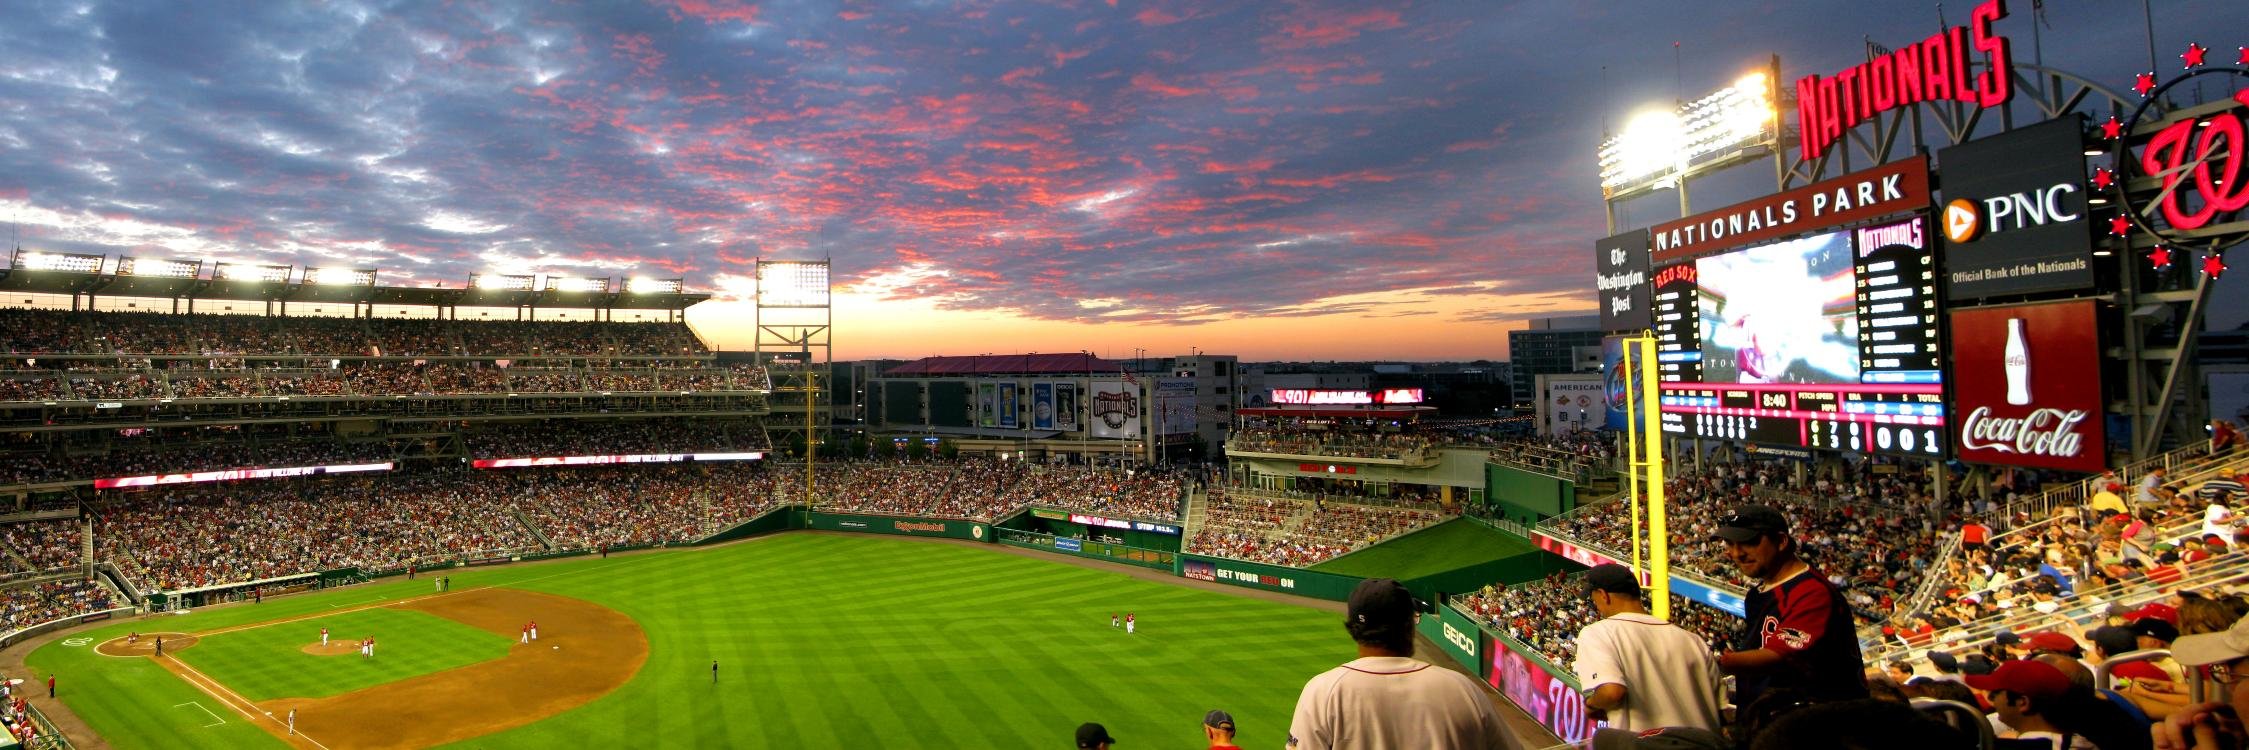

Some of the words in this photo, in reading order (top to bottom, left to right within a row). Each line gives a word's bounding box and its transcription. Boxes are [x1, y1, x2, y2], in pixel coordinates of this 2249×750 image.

[1796, 0, 2014, 160] NATIONALS
[1656, 200, 1796, 251] NATIONALS
[1813, 173, 1901, 217] PARK
[1984, 183, 2077, 233] PNC
[1858, 218, 1923, 258] NATIONALS
[1611, 248, 1626, 266] The
[1598, 270, 1643, 291] Washington
[1656, 267, 1675, 289] RED
[1676, 265, 1697, 283] SOX
[1953, 269, 1983, 283] Official
[1985, 267, 2008, 280] Bank
[2010, 265, 2019, 277] of
[2020, 264, 2036, 275] the
[2037, 258, 2086, 273] Nationals
[1612, 296, 1630, 317] Post
[1093, 398, 1137, 417] NATIONALS
[1763, 394, 1787, 407] 8:40
[1918, 394, 1941, 402] TOTAL
[1811, 420, 1819, 433] 6
[1829, 421, 1838, 434] 7
[1962, 406, 2091, 457] Coca-Cola
[1812, 434, 1820, 446] 1
[1830, 434, 1839, 448] 3
[1877, 427, 1891, 449] 0
[1899, 428, 1914, 451] 0
[1924, 430, 1939, 453] 1
[1185, 571, 1215, 582] NATSTOWN
[1217, 568, 1233, 579] GET
[1235, 571, 1259, 583] YOUR
[1280, 578, 1295, 588] ON
[1443, 622, 1475, 657] GEICO
